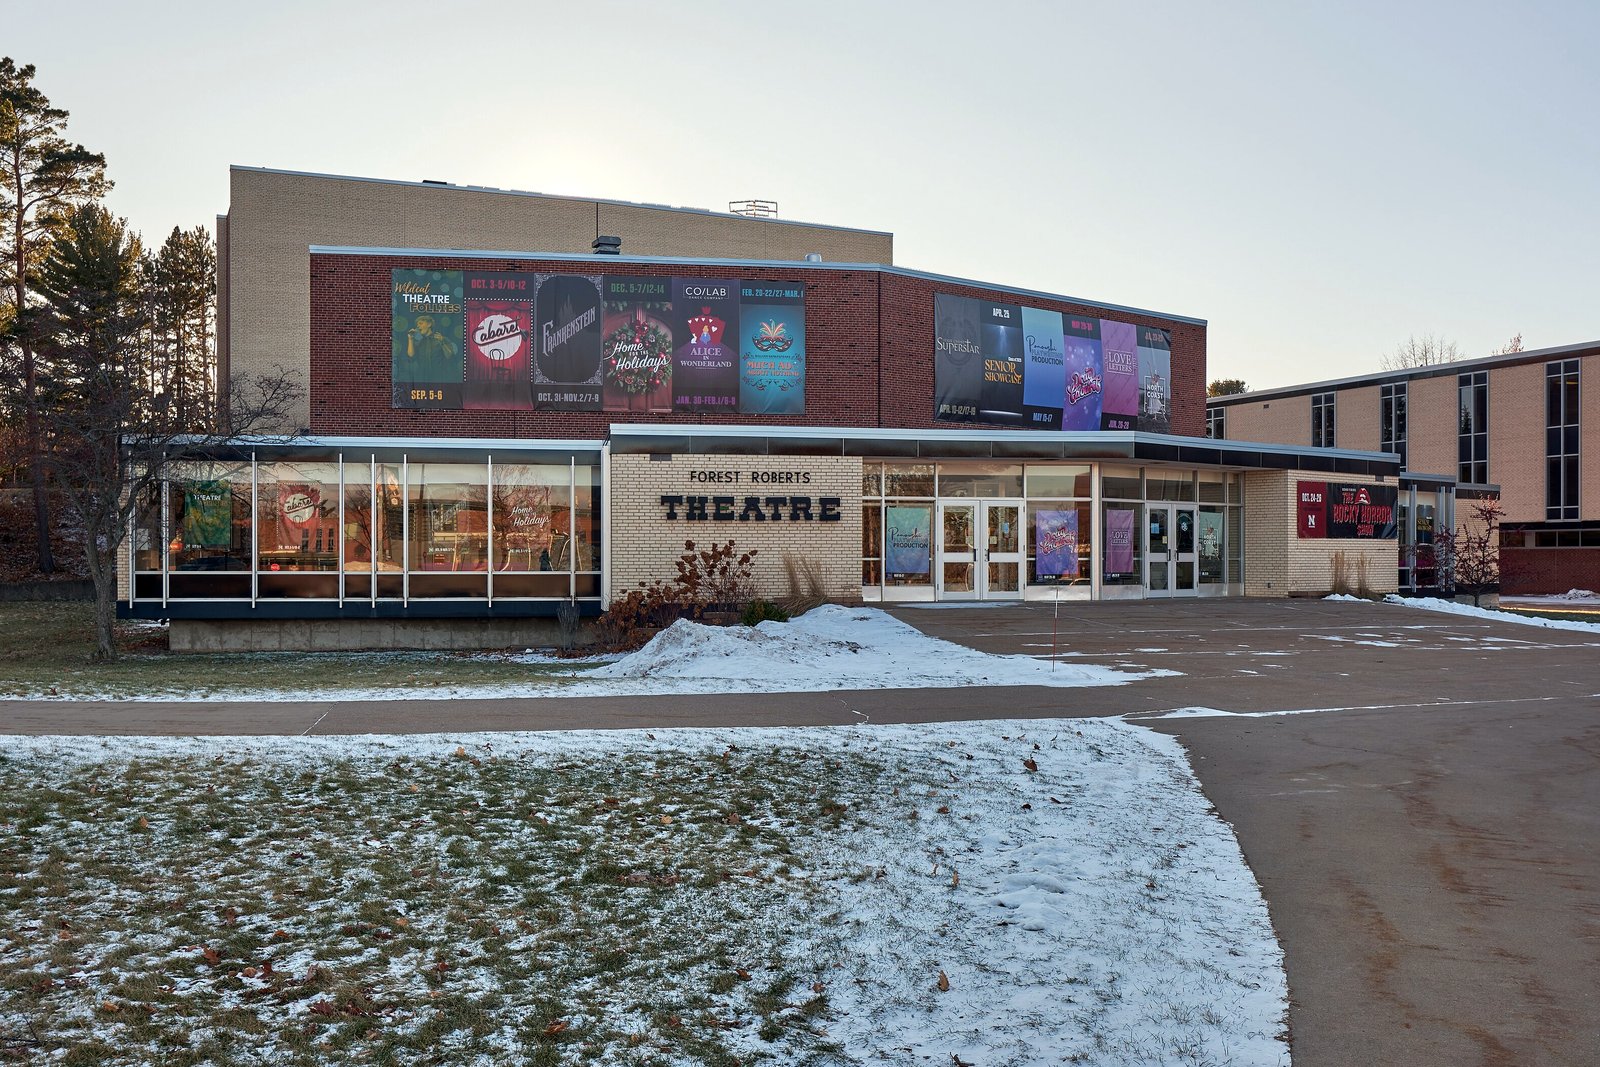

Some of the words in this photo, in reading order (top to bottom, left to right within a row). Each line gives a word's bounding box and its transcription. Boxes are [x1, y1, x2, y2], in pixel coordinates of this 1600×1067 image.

[394, 281, 430, 293] Wildcat
[471, 279, 488, 289] OCT.
[611, 283, 627, 293] DEC.
[630, 284, 664, 293] 5-7/12-14
[685, 287, 727, 296] CO/LAB
[742, 288, 754, 296] FEB.
[403, 294, 450, 304] THEATRE
[410, 303, 461, 313] FOLLIES
[473, 316, 528, 346] Cabaret
[542, 307, 596, 356] FRANKENSTEIN
[608, 341, 644, 355] Home
[690, 347, 722, 356] ALICE
[616, 354, 671, 373] Holidays
[1032, 356, 1063, 366] PRODUCTION
[1108, 352, 1131, 365] LOVE
[680, 360, 732, 368] WONDERLAND
[985, 359, 1016, 373] SENIOR
[1109, 362, 1132, 372] LETTERS
[985, 371, 1022, 384] SHOWCASE
[1147, 384, 1163, 392] NORTH
[411, 390, 427, 400] SEP.
[429, 390, 443, 400] 5-6
[538, 393, 552, 402] OCT.
[1147, 391, 1163, 399] COAST
[676, 396, 692, 405] JAN.
[690, 471, 741, 483] FOREST
[751, 471, 811, 484] ROBERTS
[660, 495, 841, 521] THEATRE
[1333, 504, 1359, 524] ROCKY
[1361, 505, 1393, 525] HORROR
[513, 515, 551, 528] Holidays
[1308, 515, 1315, 525] N
